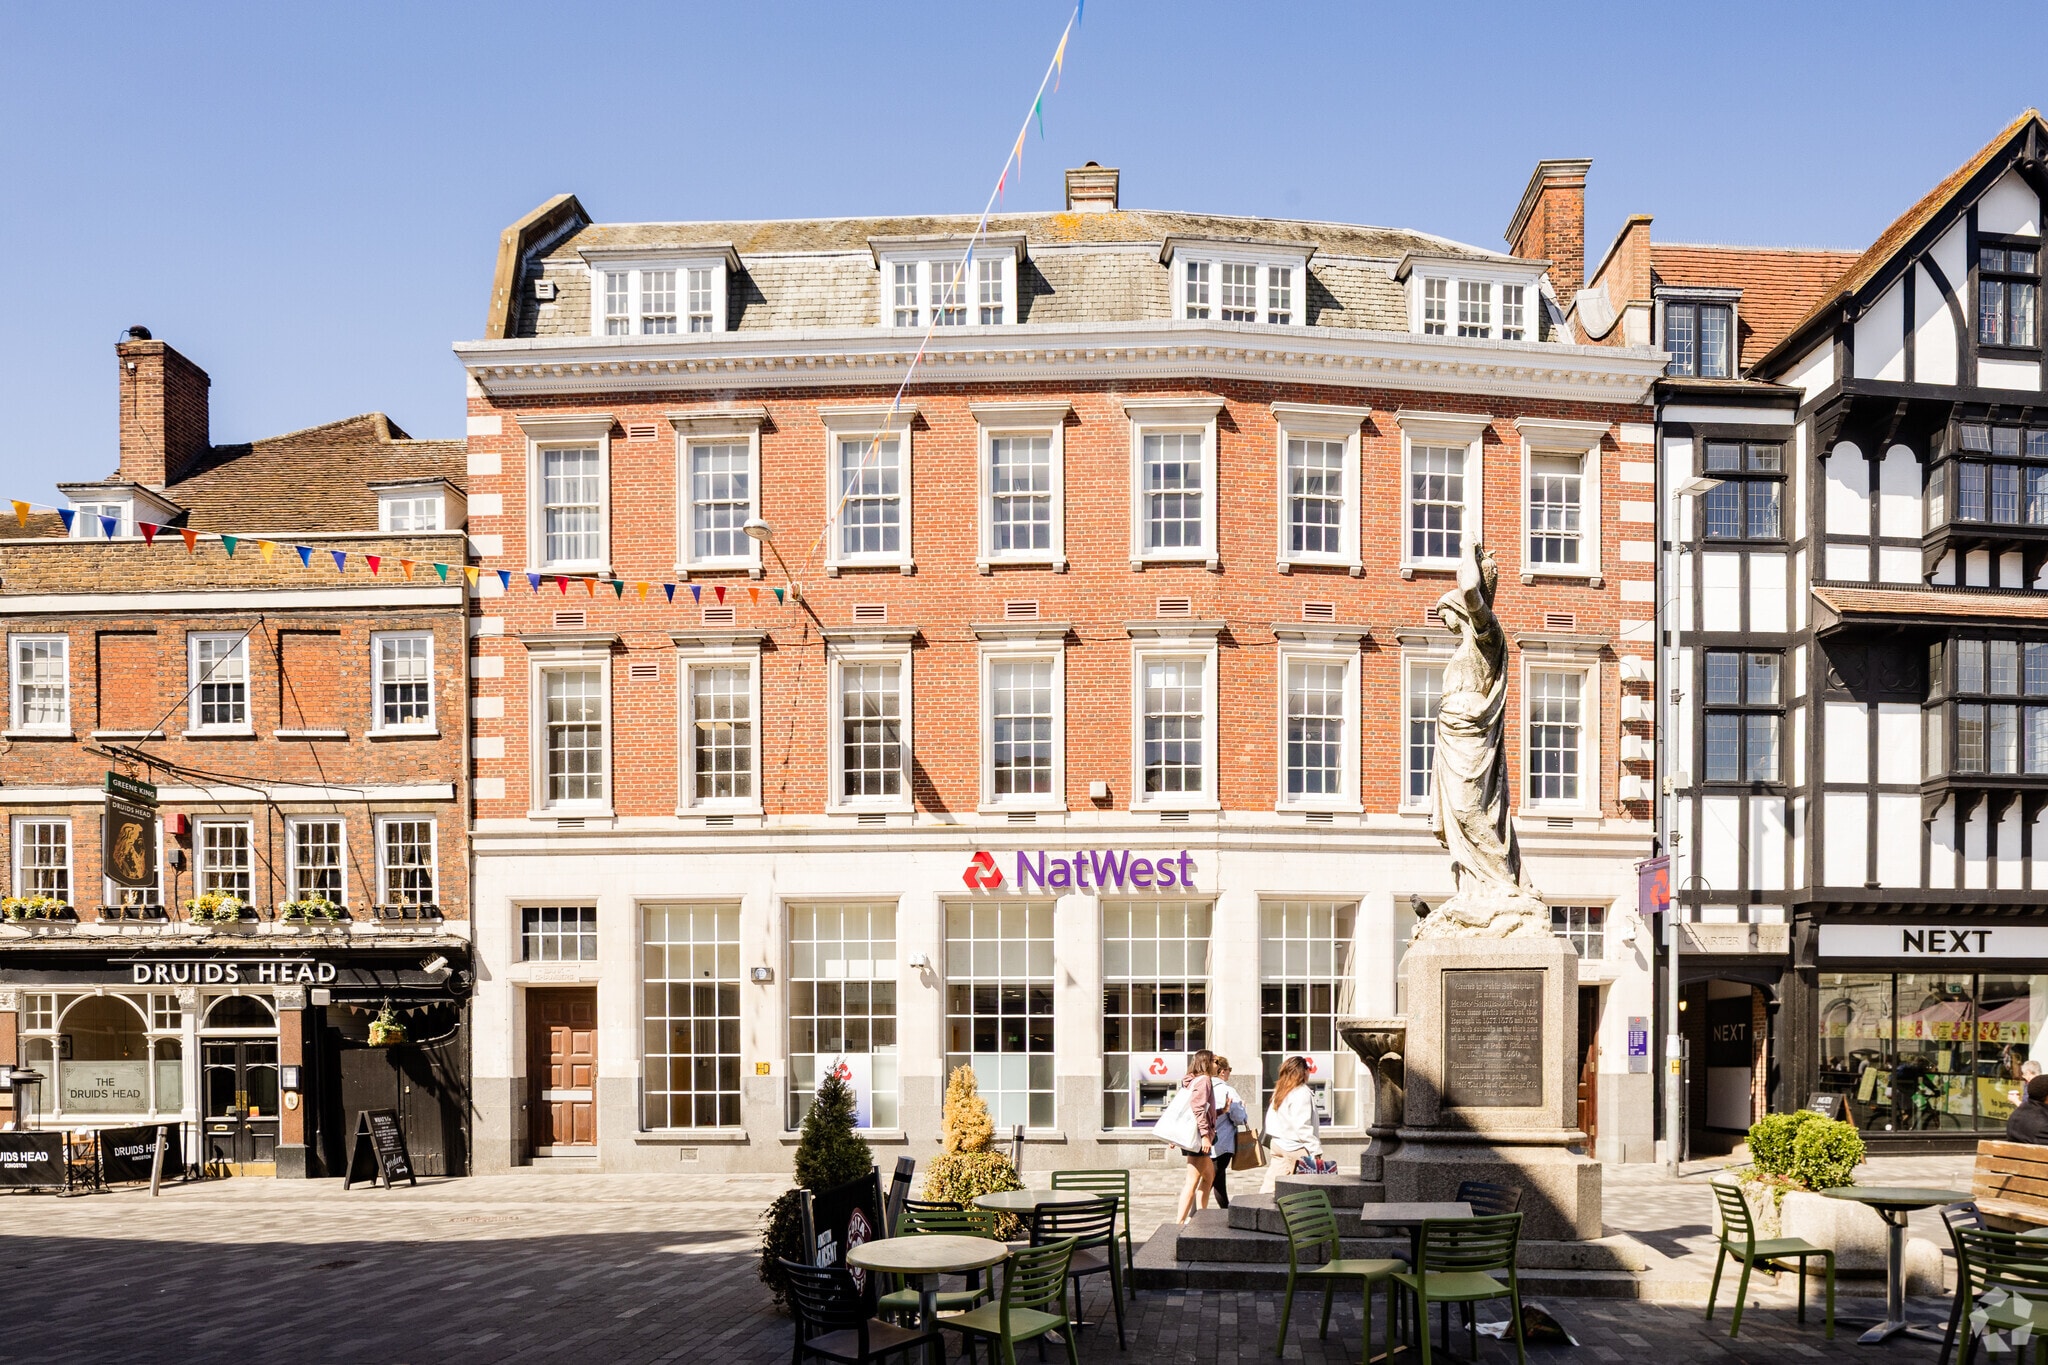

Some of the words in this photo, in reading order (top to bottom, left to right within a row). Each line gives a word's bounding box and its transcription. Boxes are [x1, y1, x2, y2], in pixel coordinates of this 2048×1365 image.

[112, 779, 138, 793] GREENE
[138, 787, 155, 798] KING
[112, 801, 135, 813] DRUIDS
[134, 808, 151, 818] HEAD
[1016, 849, 1194, 888] NatWest
[1903, 929, 1992, 953] NEXT
[133, 962, 239, 983] DRUIDS
[258, 962, 337, 983] HEAD
[1713, 1024, 1746, 1041] NEXT
[95, 1077, 116, 1087] THE
[70, 1089, 109, 1099] DRUIDS
[112, 1089, 141, 1099] HEAD
[20, 1151, 49, 1162] HEAD
[114, 1144, 144, 1157] DRUIDS
[145, 1142, 170, 1153] HED
[382, 1154, 405, 1178] Garden
